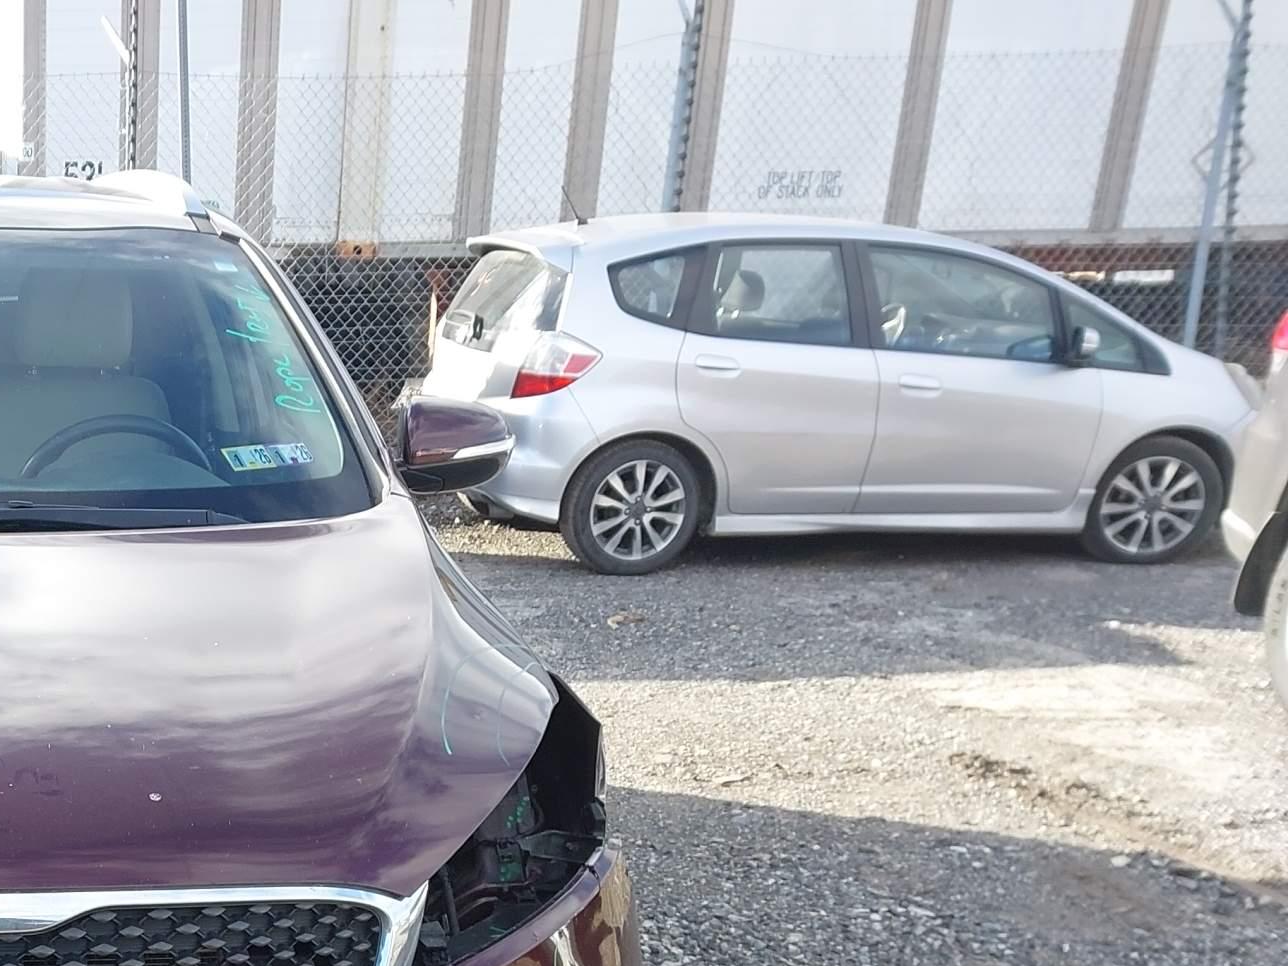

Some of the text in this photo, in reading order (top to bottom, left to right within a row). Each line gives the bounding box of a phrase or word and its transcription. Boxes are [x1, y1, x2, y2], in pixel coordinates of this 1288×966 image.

[767, 170, 788, 185] TOP
[757, 183, 844, 200] OF STACK ONLY
